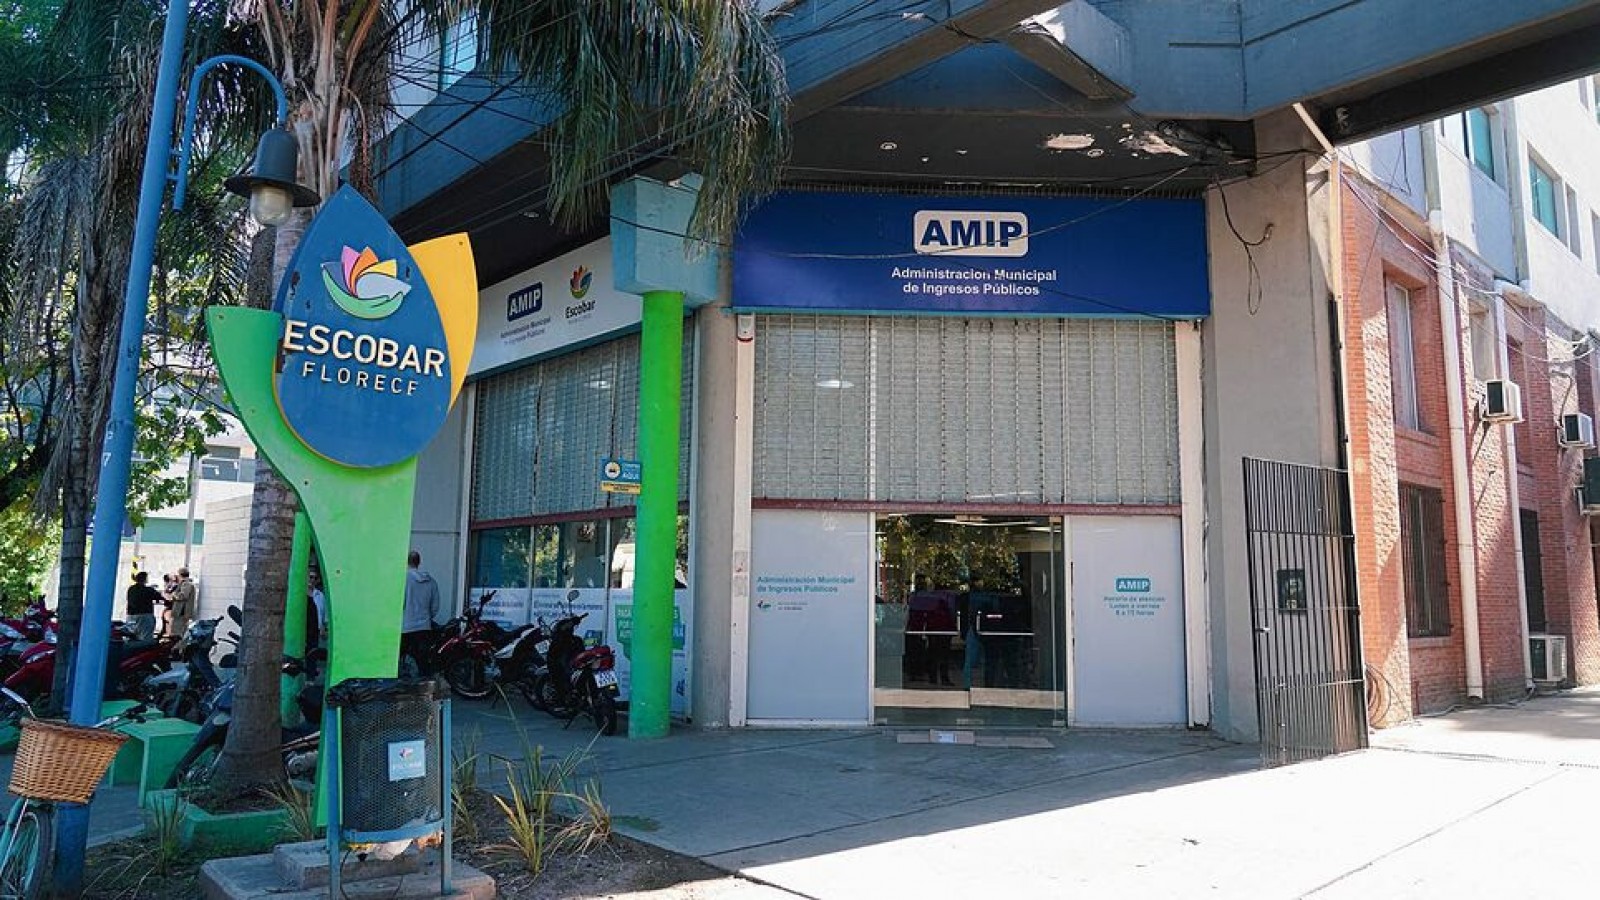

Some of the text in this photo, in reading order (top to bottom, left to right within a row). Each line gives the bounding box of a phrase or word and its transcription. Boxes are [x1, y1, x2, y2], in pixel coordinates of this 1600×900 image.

[921, 219, 1023, 248] AMIP
[994, 269, 1057, 283] Municipal
[903, 282, 1041, 296] de Ingresos Públicos
[510, 287, 542, 316] AMIP
[565, 300, 596, 319] Escobar
[282, 319, 446, 378] ESCOBAR
